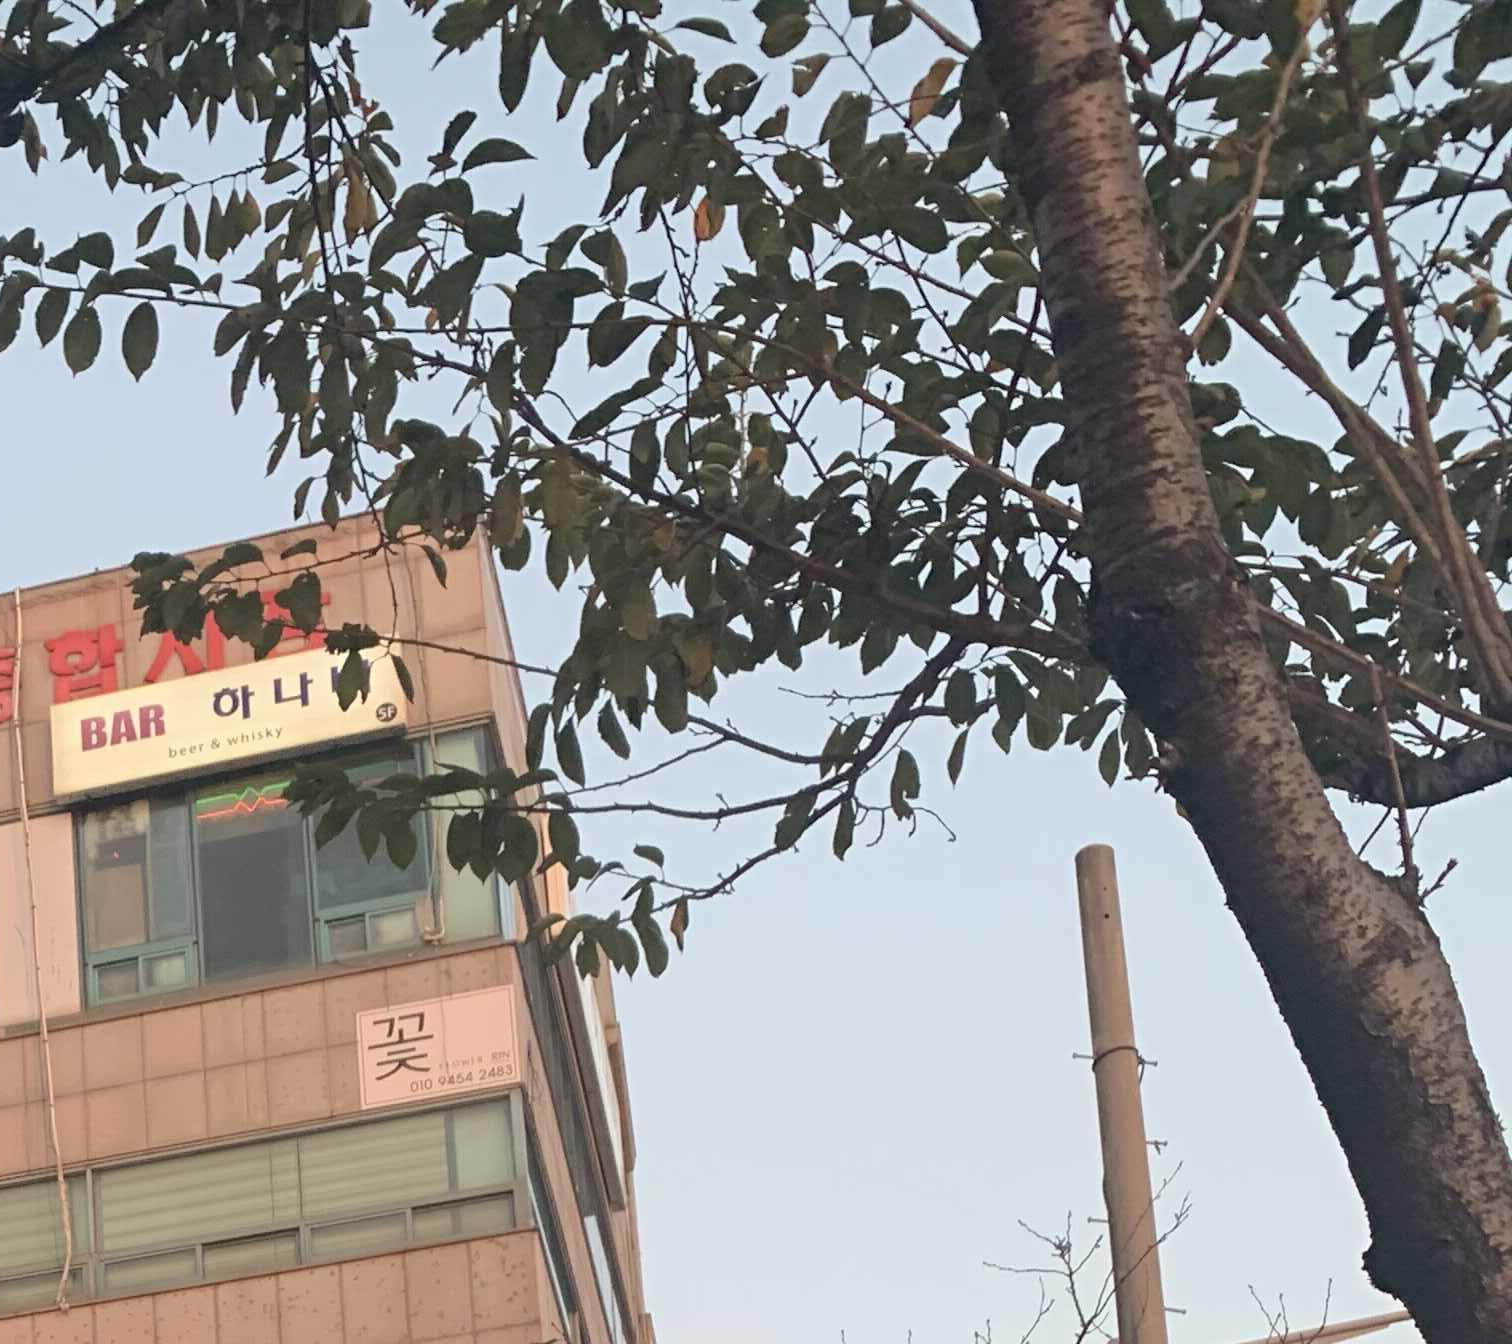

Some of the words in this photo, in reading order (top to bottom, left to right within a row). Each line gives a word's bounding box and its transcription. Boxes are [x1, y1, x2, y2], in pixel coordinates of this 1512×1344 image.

[80, 703, 166, 752] BAR
[167, 742, 206, 759] beer
[210, 736, 221, 750] &
[226, 725, 285, 745] whisky
[368, 1012, 434, 1081] 꽃
[410, 1079, 433, 1093] 010
[438, 1072, 473, 1086] 9454
[479, 1064, 513, 1081] 2483
